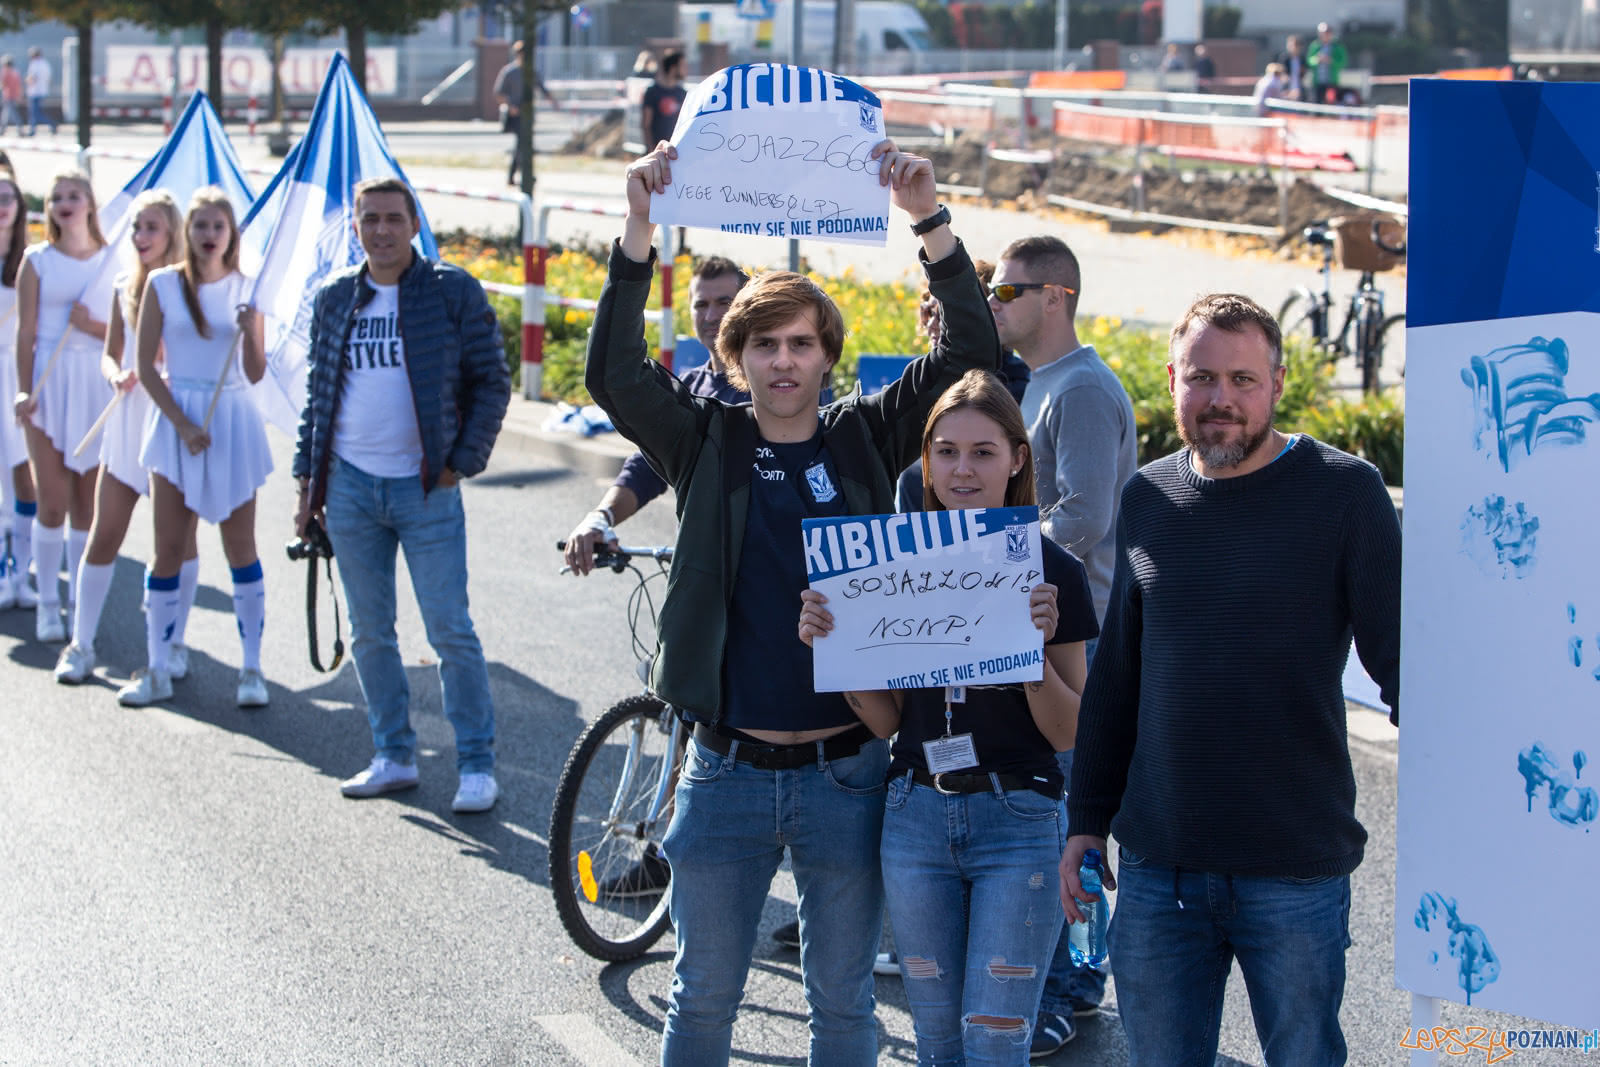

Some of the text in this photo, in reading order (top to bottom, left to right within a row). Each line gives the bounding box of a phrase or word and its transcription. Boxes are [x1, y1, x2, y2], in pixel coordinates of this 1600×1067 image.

[674, 182, 712, 200] VEGE
[767, 222, 785, 238] SIĘ
[791, 220, 811, 235] NIE
[930, 668, 950, 685] SIĘ
[954, 664, 975, 680] NIE
